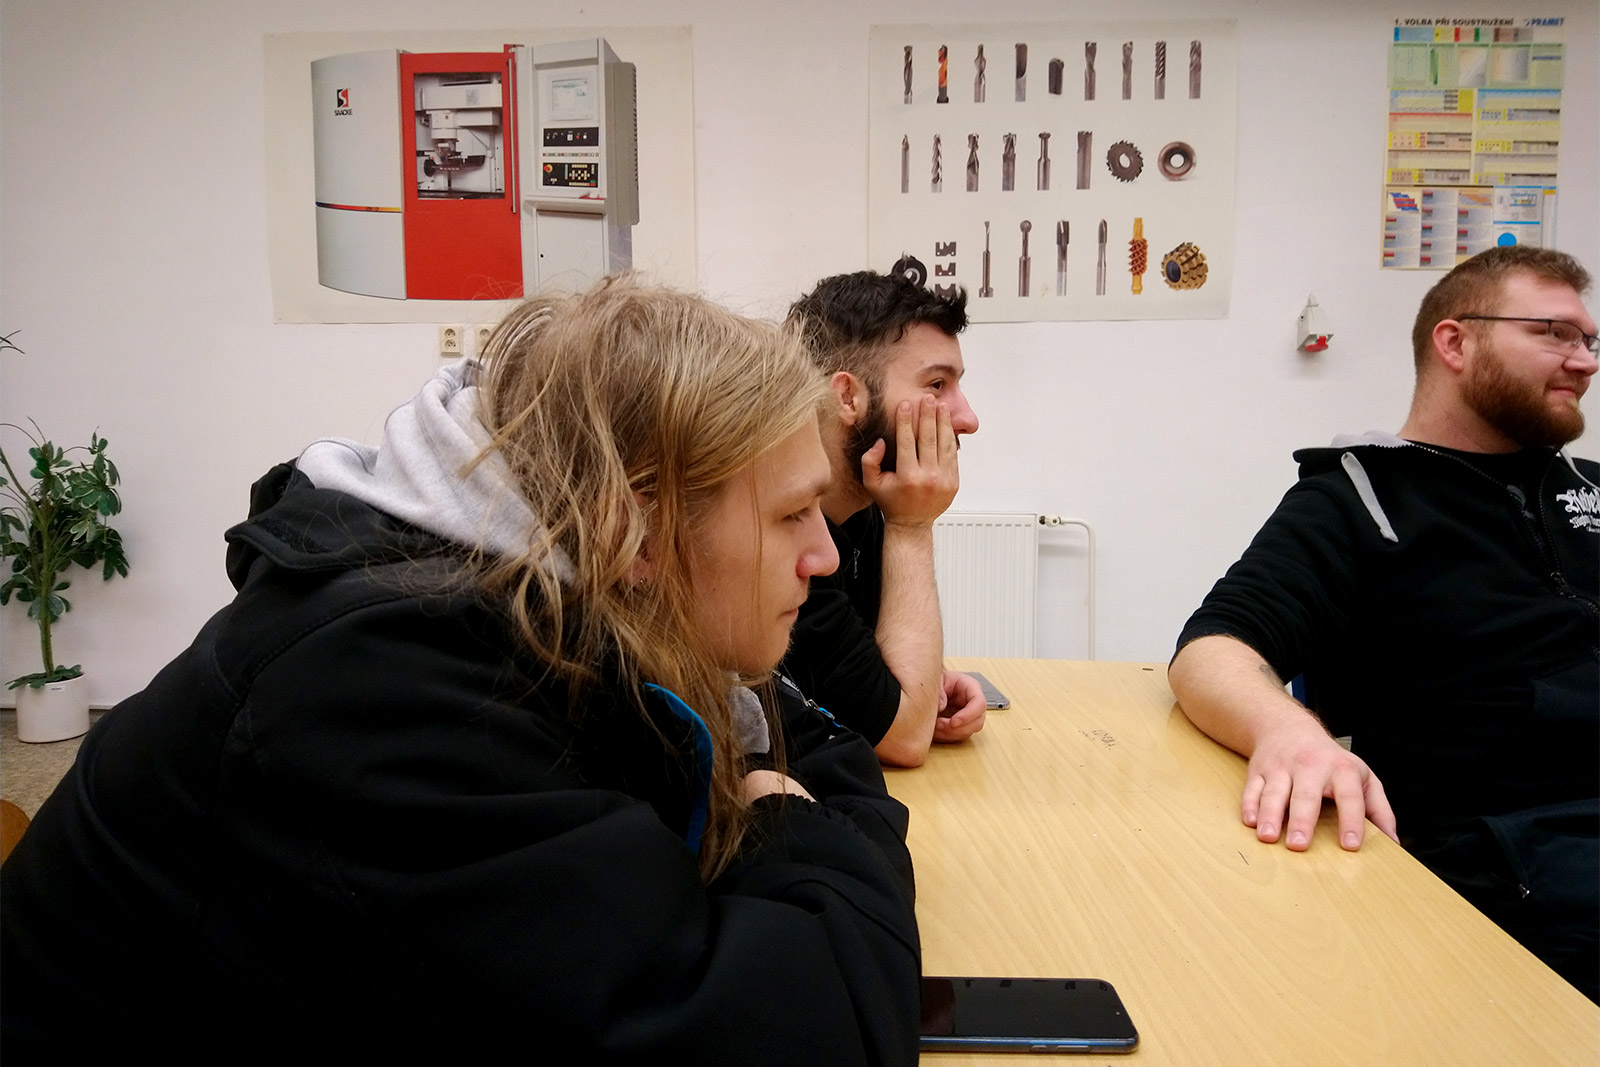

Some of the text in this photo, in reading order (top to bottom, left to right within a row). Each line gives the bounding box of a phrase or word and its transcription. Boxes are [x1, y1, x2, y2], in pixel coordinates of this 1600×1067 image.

[1405, 18, 1433, 26] VOLBA
[1435, 17, 1450, 26] PŘI
[1452, 16, 1514, 26] SOUSTRUŽENÍ
